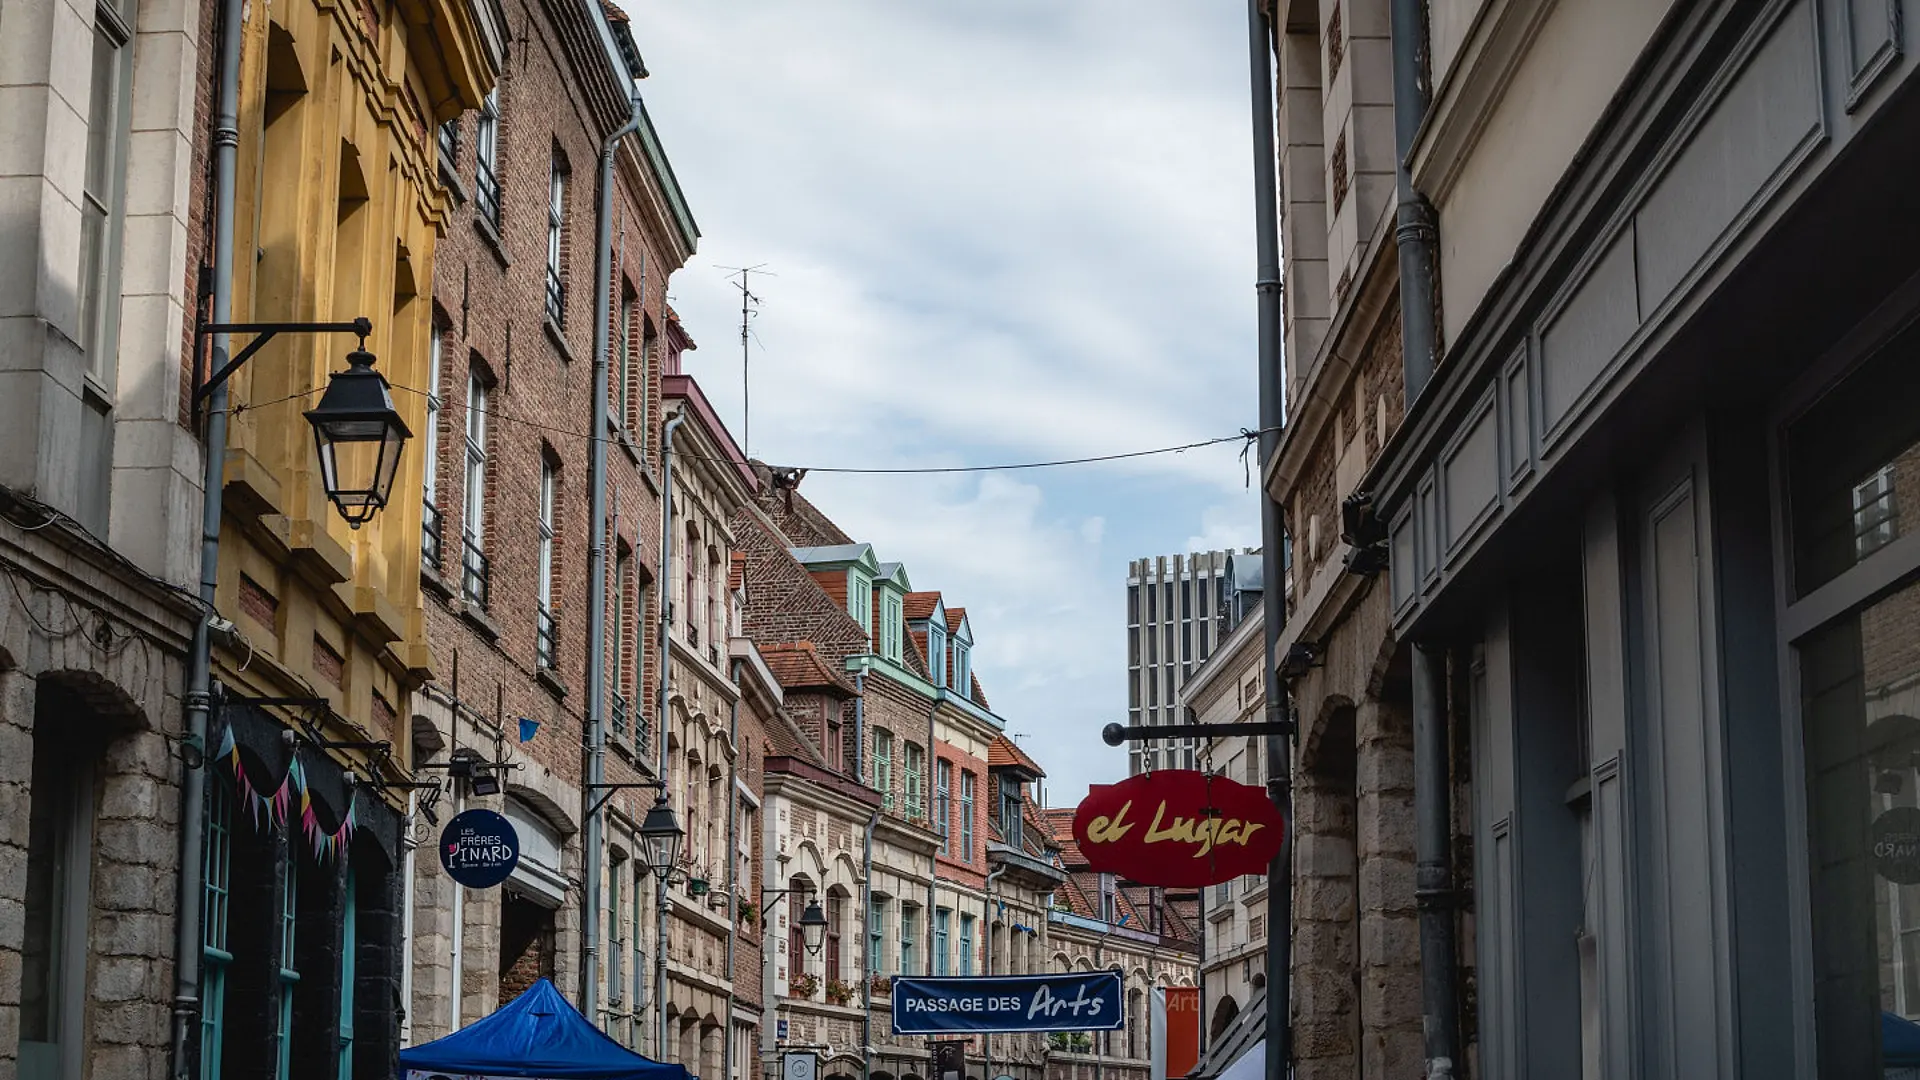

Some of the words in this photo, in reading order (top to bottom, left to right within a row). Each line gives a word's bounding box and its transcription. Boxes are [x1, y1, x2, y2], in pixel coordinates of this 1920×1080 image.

[1087, 800, 1135, 843] el
[1144, 800, 1265, 858] Lugar
[906, 998, 983, 1012] PASSAGE
[988, 997, 1021, 1011] DES
[1027, 984, 1104, 1020] Arts
[1167, 992, 1199, 1012] Art
